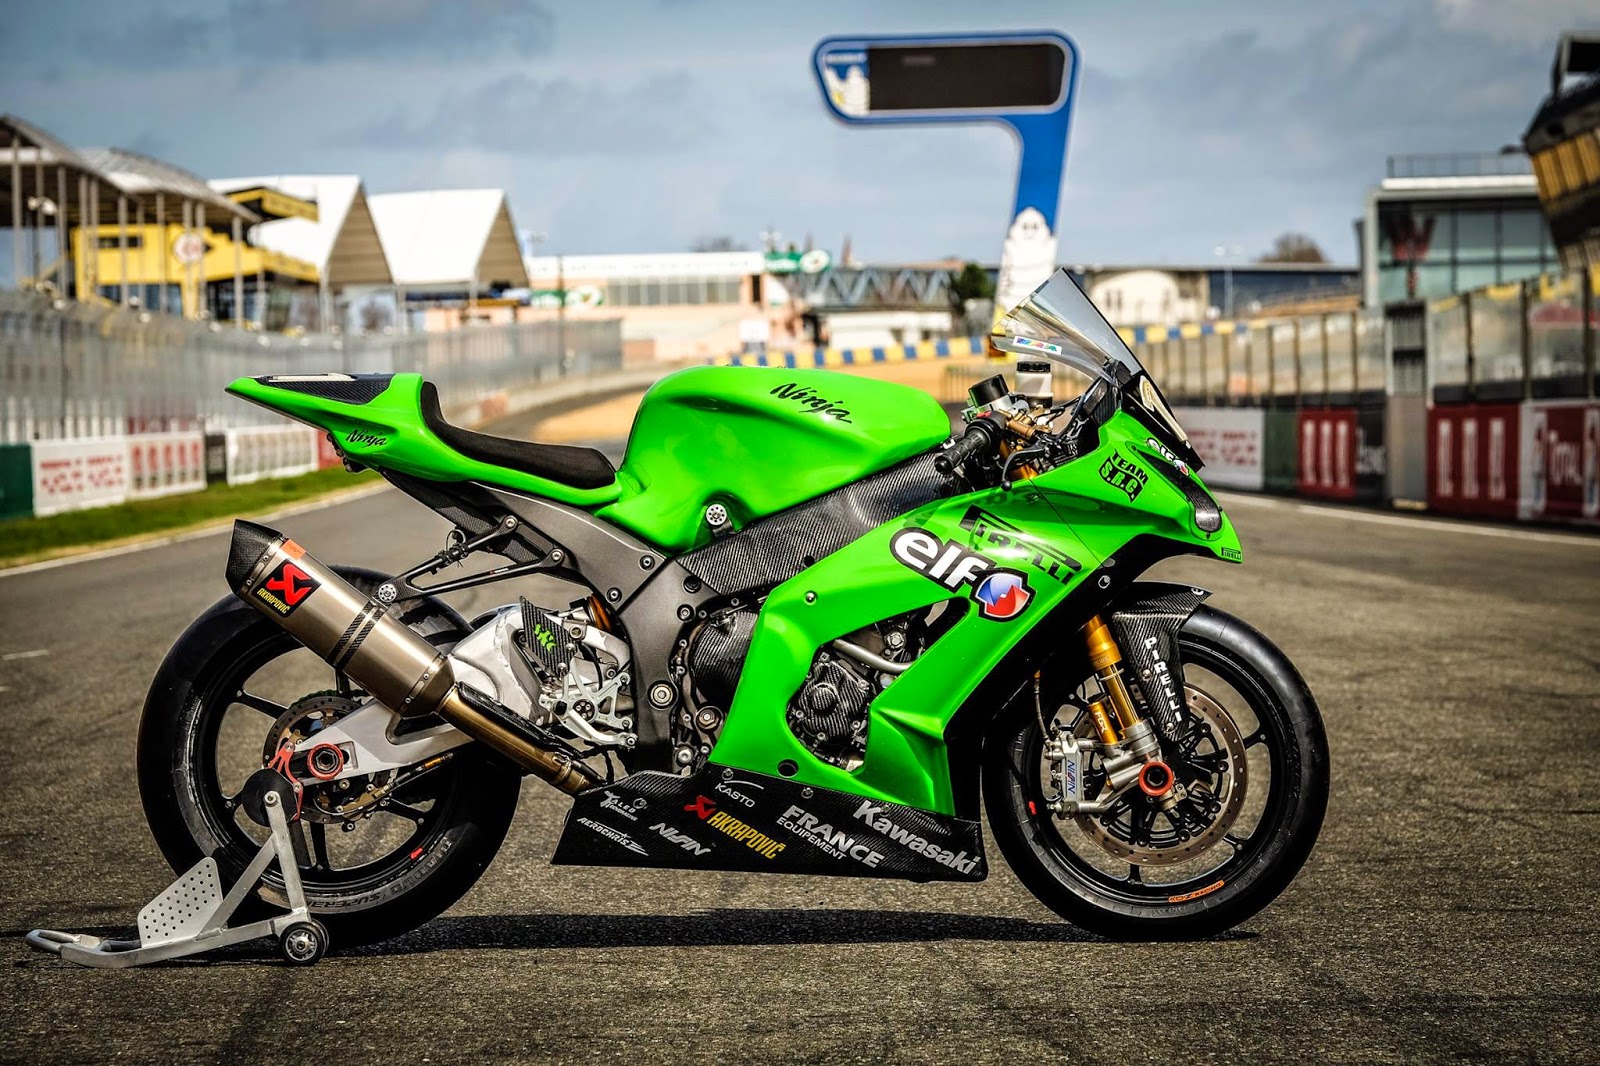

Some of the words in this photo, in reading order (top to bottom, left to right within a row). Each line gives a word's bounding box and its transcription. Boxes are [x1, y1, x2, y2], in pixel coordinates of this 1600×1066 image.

[769, 382, 853, 424] Ninja
[345, 428, 388, 449] Ninja
[1111, 449, 1149, 486] TEAM
[891, 528, 995, 591] elf
[1143, 635, 1183, 723] PIRELLI
[714, 781, 757, 809] KASTO
[776, 816, 848, 861] EQUIPEMENT
[781, 804, 886, 869] FRANCE
[852, 799, 982, 876] Kawasaki
